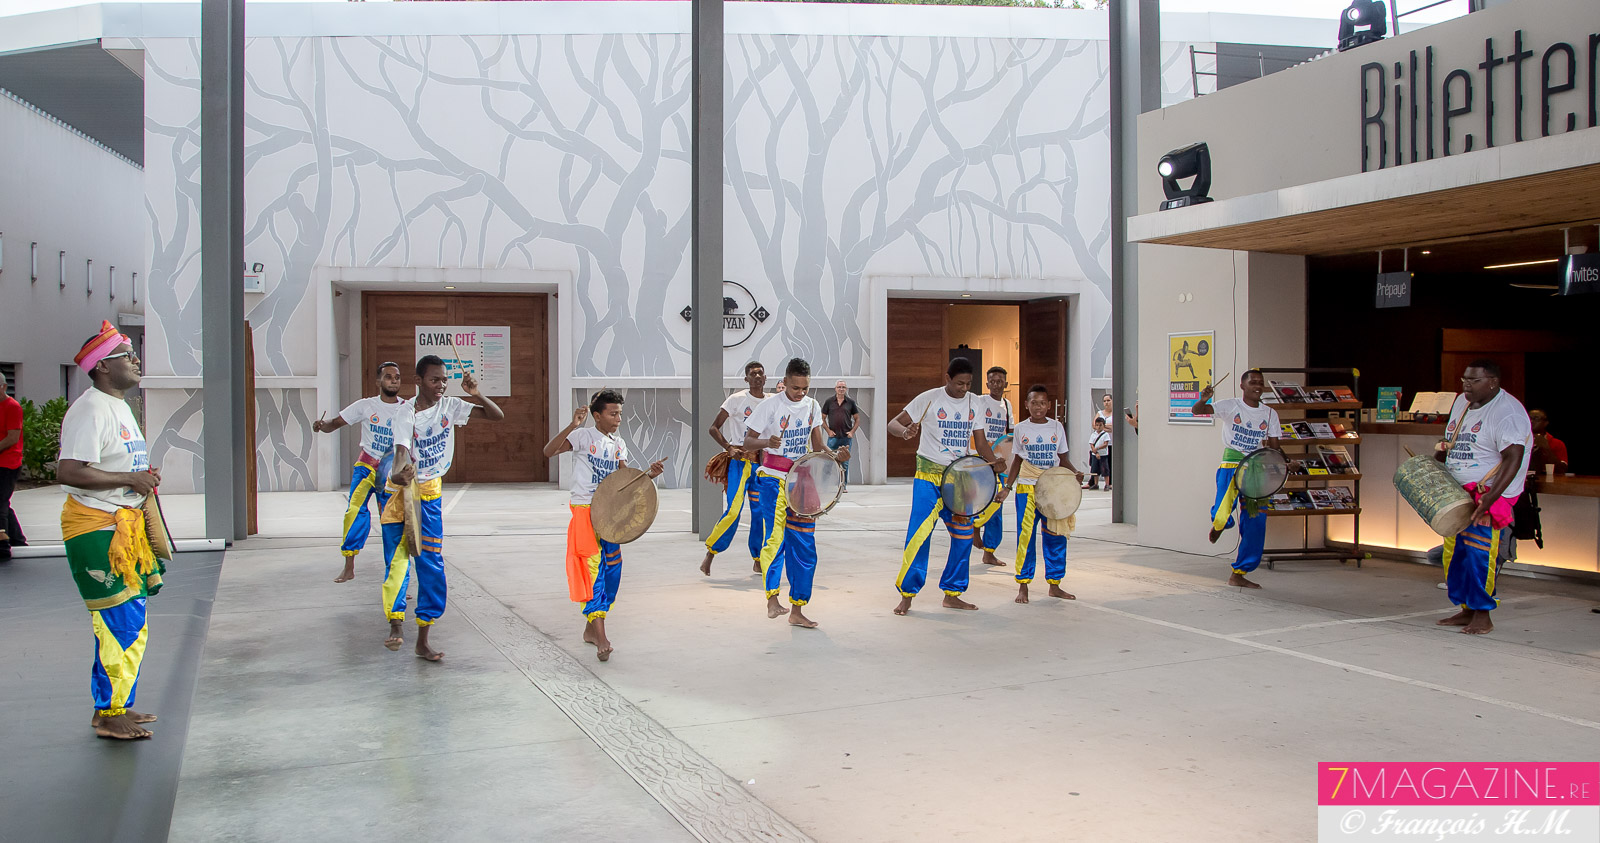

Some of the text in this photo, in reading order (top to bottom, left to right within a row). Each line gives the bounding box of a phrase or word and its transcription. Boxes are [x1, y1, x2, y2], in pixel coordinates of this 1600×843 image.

[1567, 267, 1599, 283] nvités
[1377, 282, 1407, 298] Prépayé
[419, 331, 476, 346] GAYAR CITÉ
[414, 427, 450, 449] AMBOURS
[1232, 424, 1266, 438] TAMBOURS
